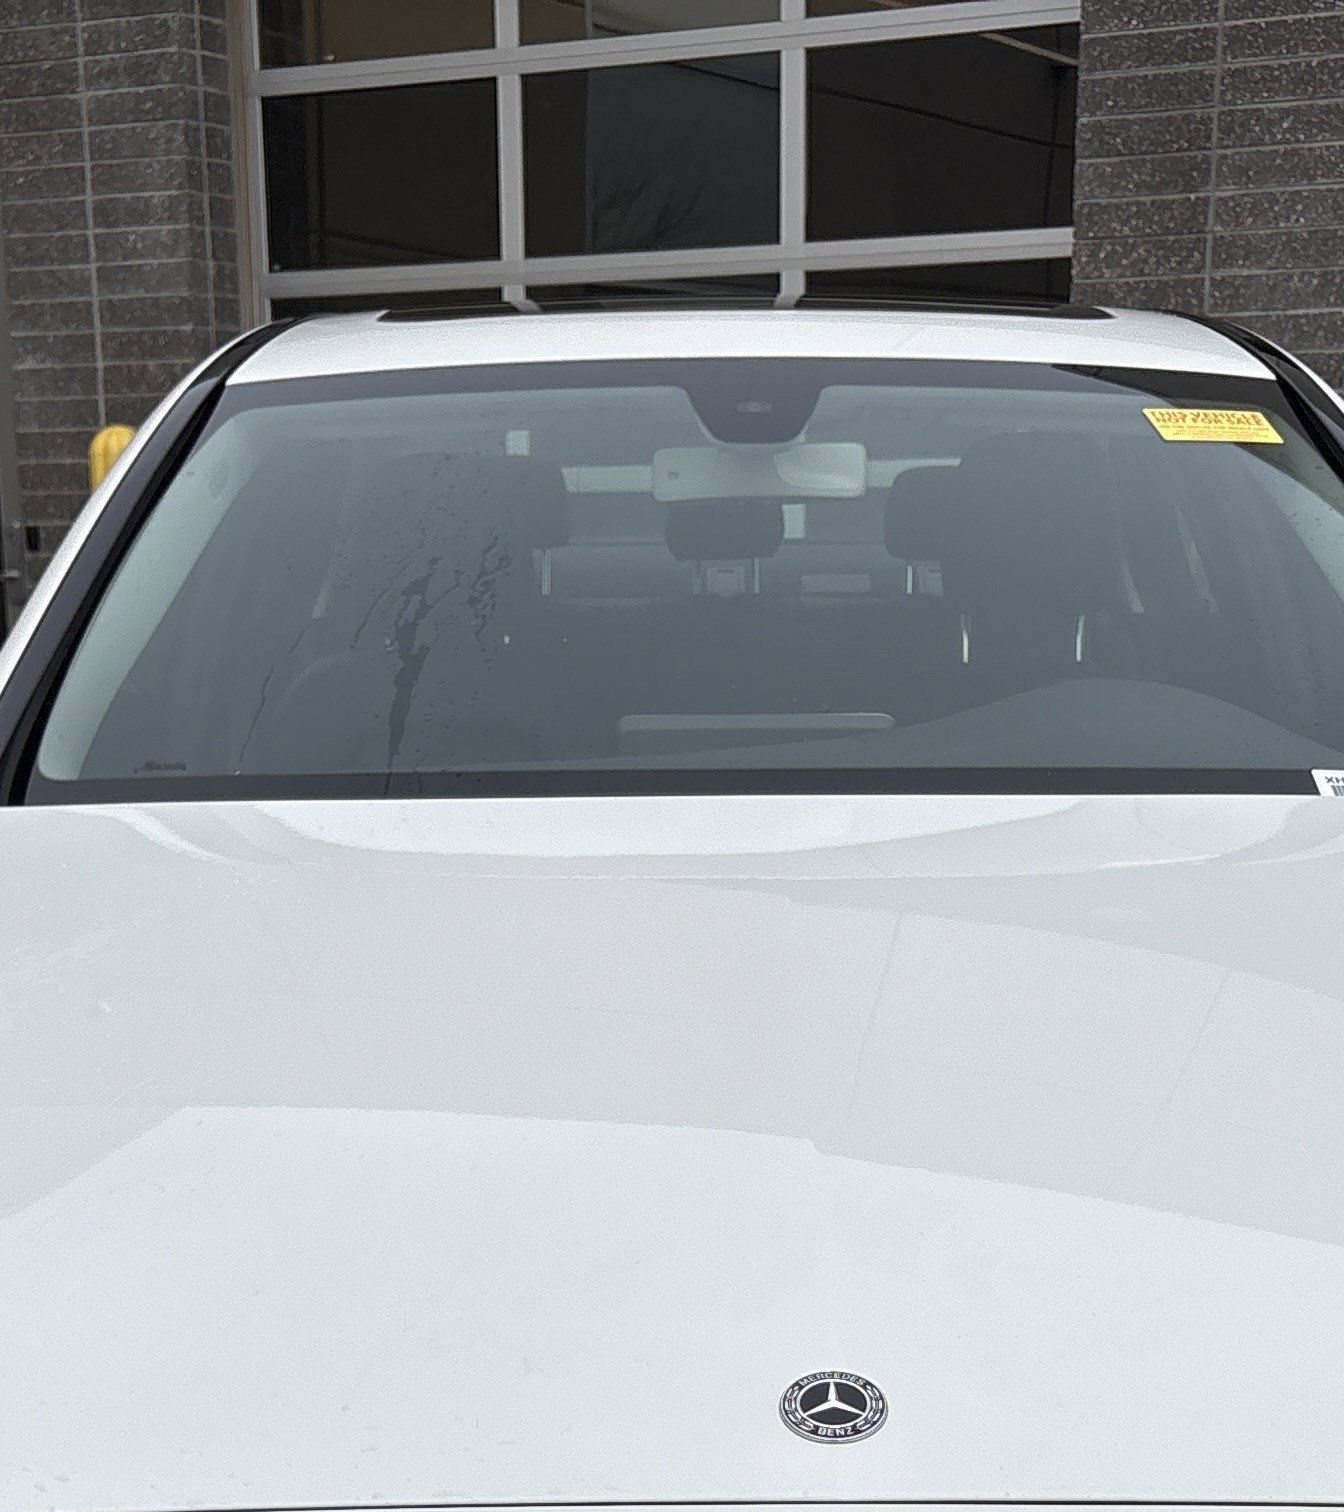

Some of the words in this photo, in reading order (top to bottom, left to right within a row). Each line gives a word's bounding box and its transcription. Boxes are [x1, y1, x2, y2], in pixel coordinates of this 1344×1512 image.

[1189, 411, 1262, 421] VEHICLE
[798, 1372, 867, 1386] MERCEDES
[817, 1426, 855, 1437] BENZ
